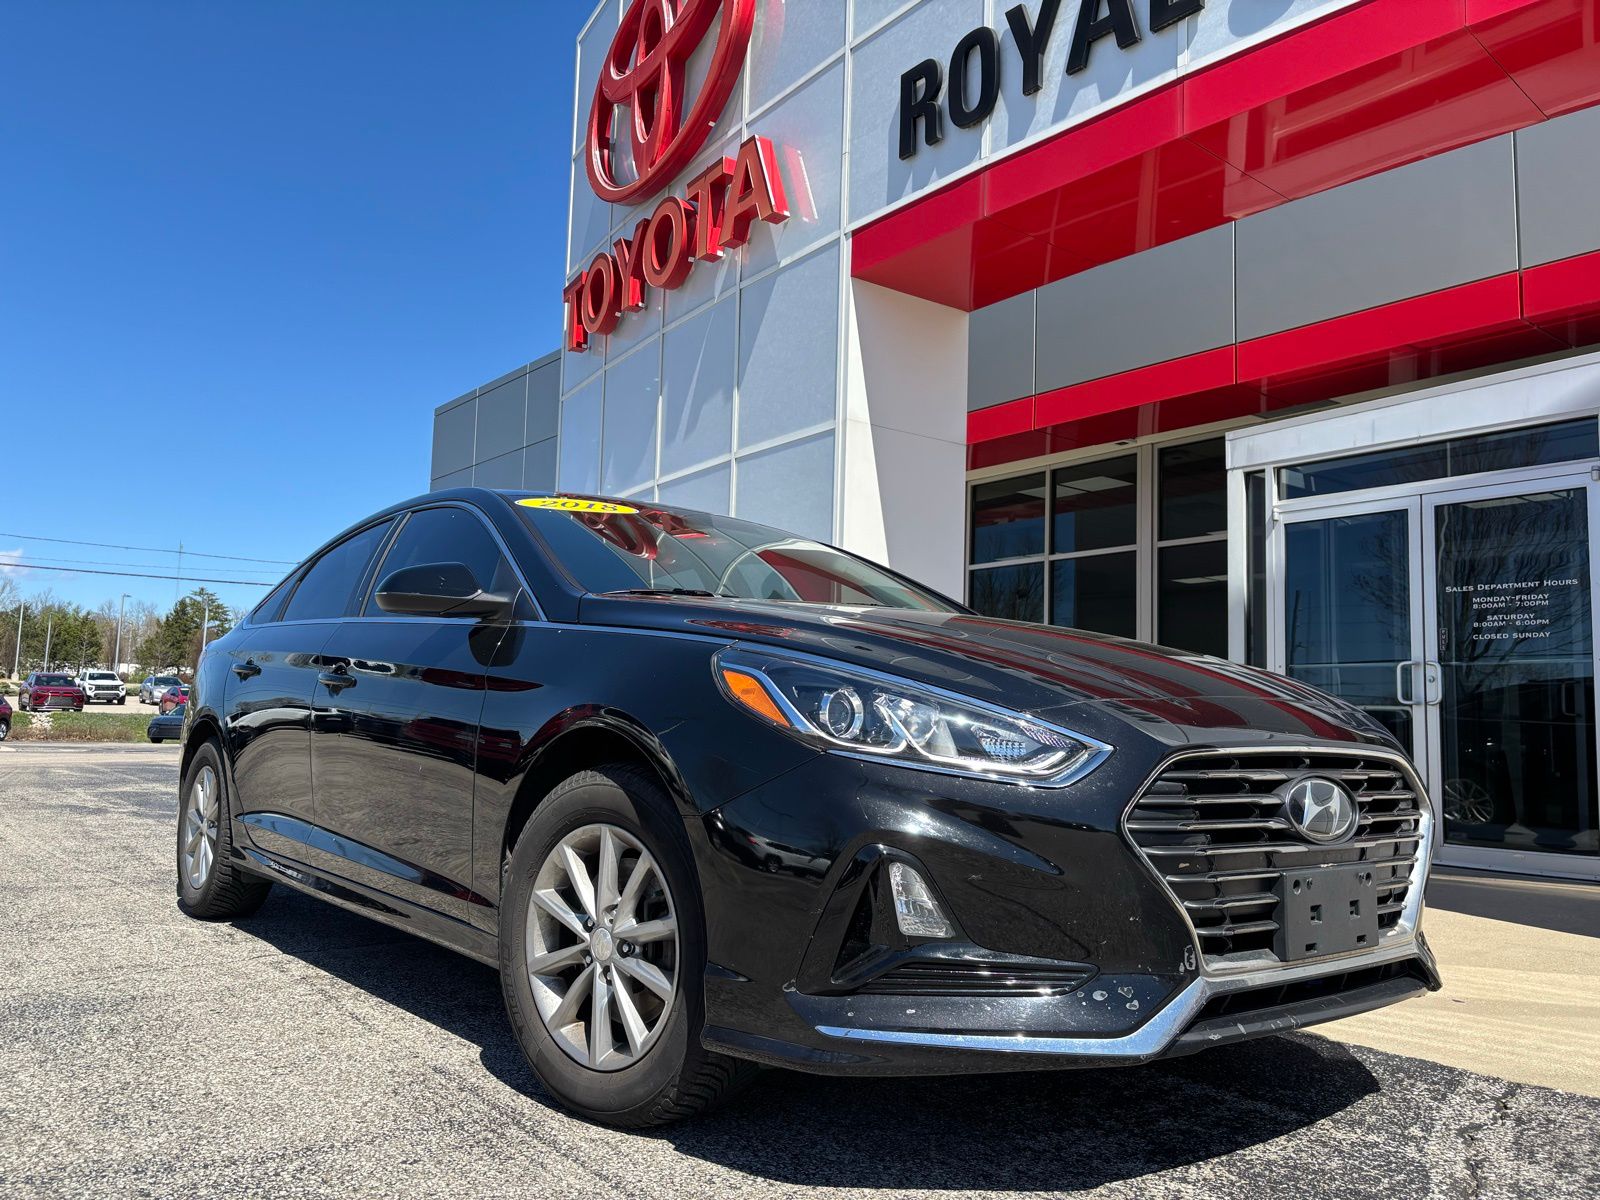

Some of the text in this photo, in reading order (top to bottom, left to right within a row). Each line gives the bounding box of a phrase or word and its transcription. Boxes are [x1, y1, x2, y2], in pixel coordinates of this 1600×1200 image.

[563, 134, 790, 353] TOYOTA
[540, 500, 618, 511] 2018
[1445, 578, 1579, 593] SALES DEPARTMENT HOURS
[1472, 593, 1550, 603] MONDAY-FRIDAY
[1486, 613, 1535, 621] SATURDAY
[1512, 631, 1551, 639] SUNDAY
